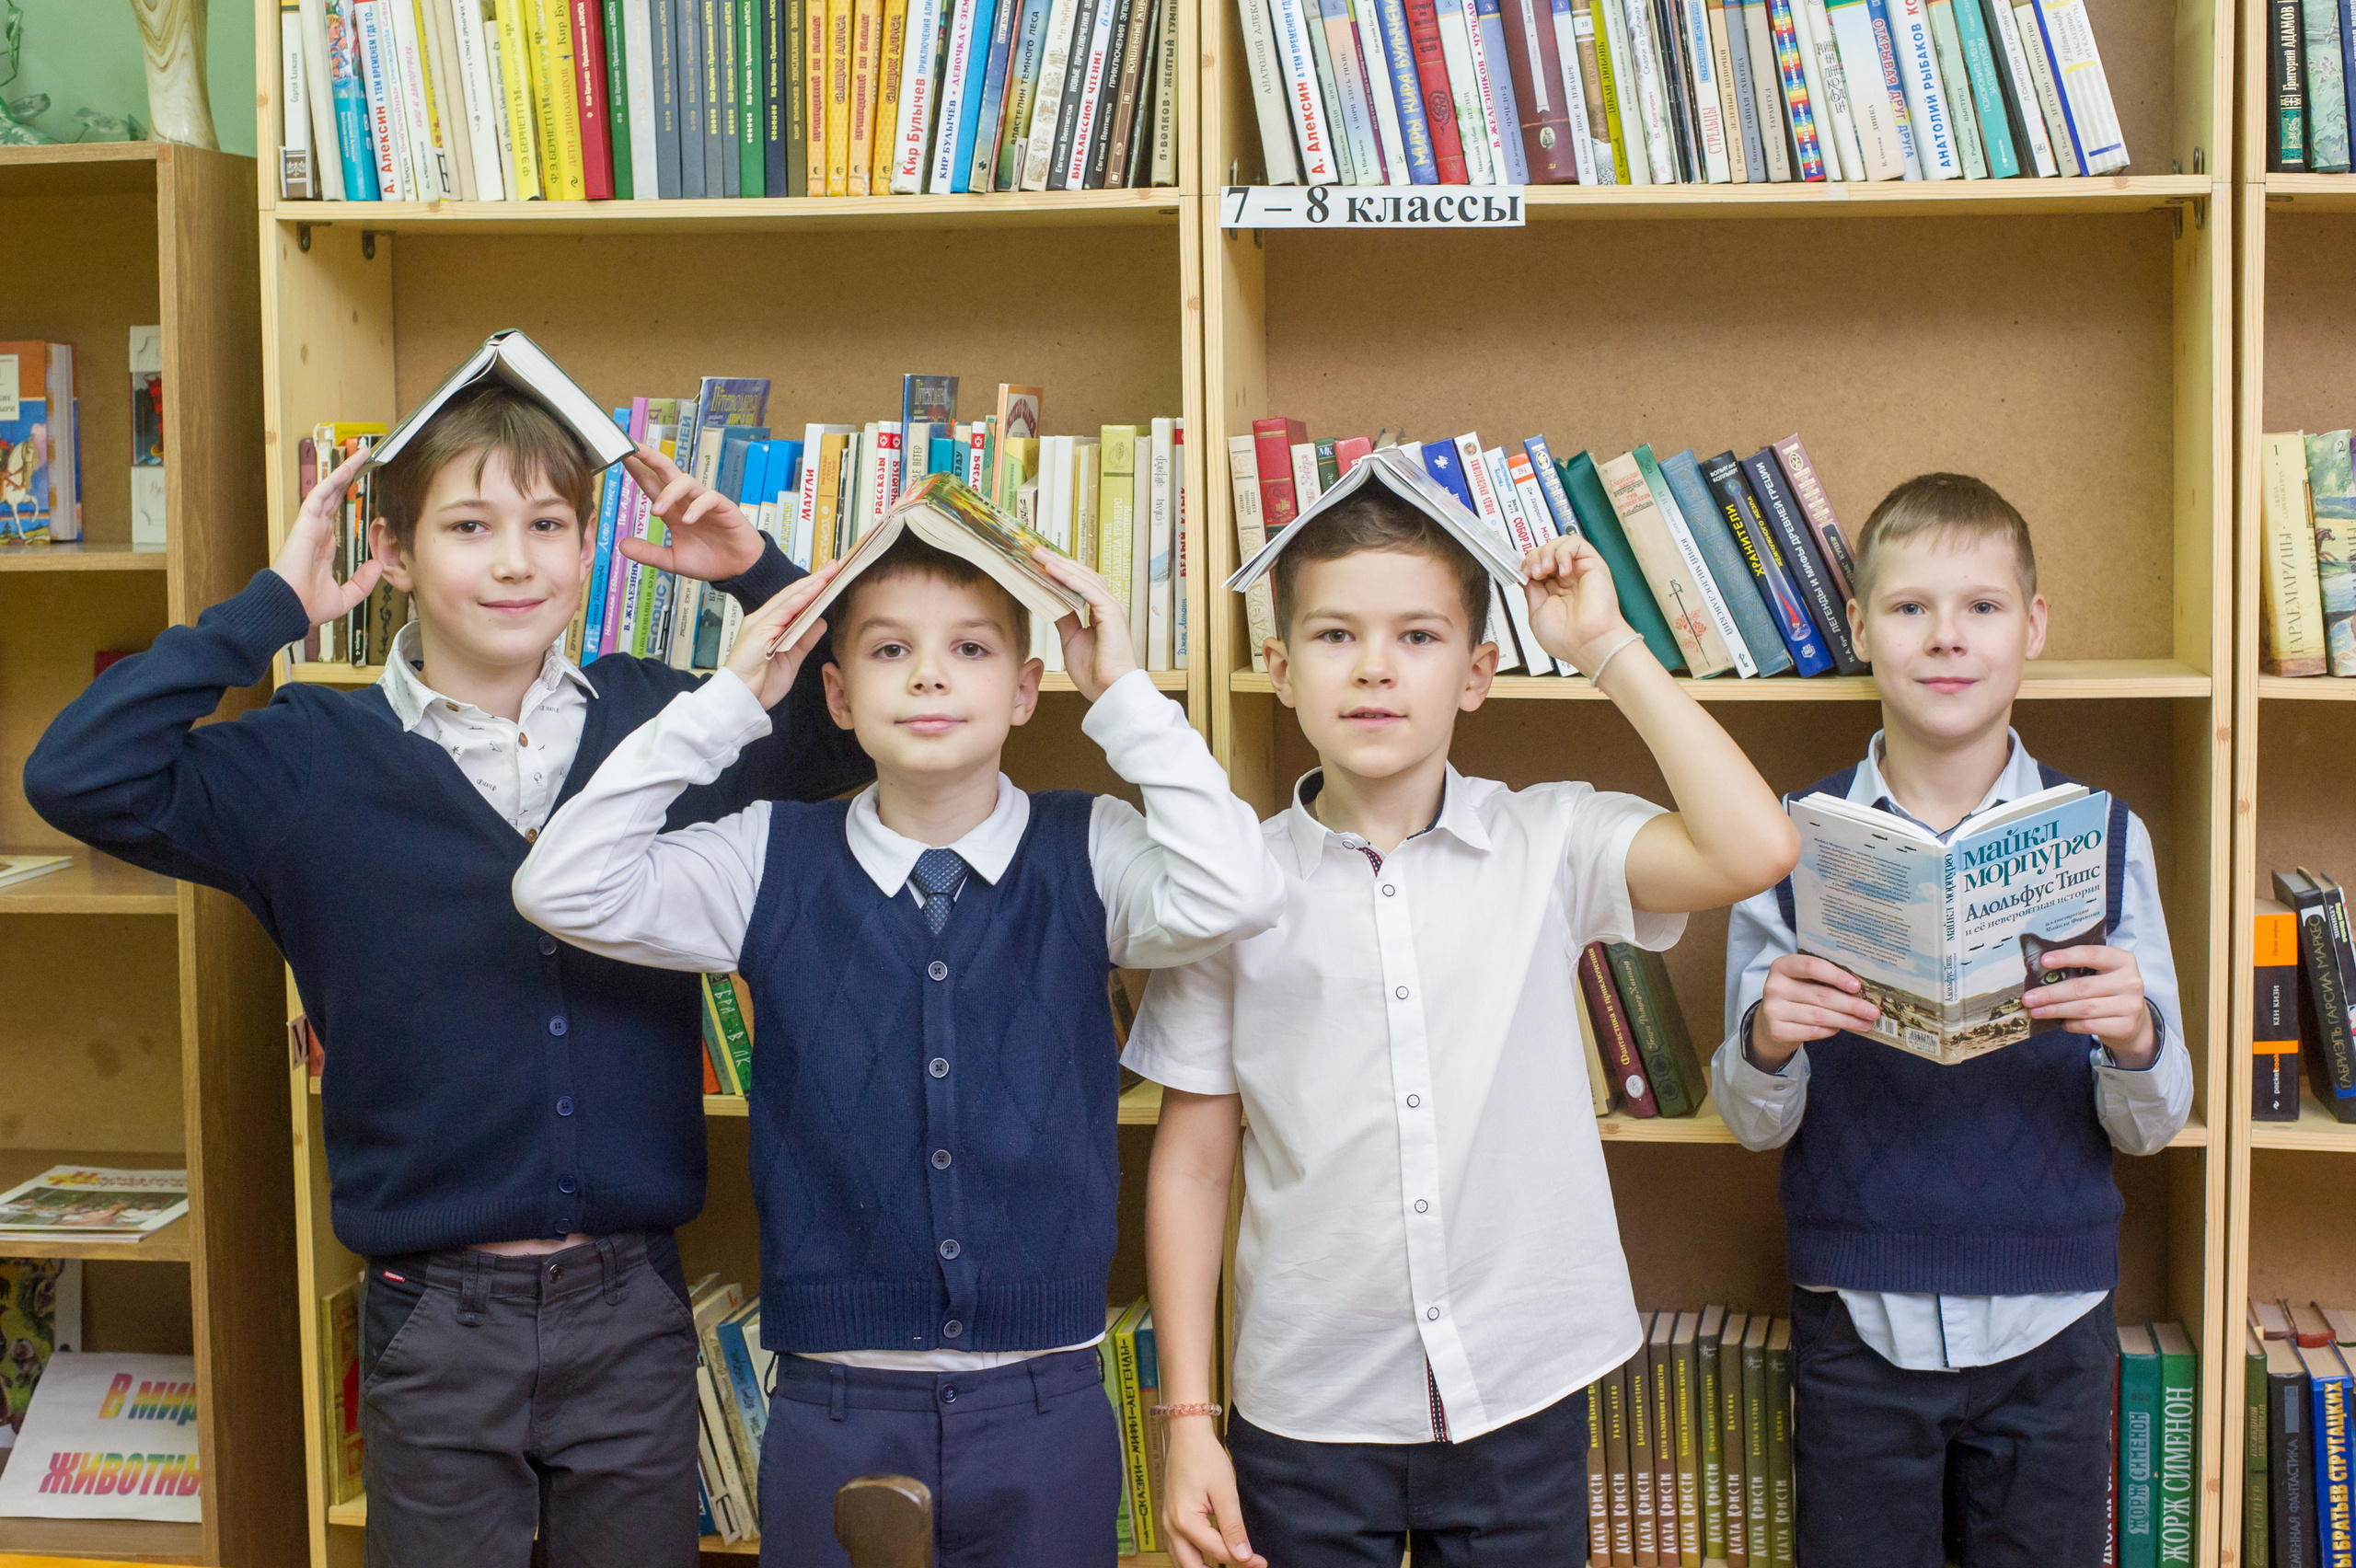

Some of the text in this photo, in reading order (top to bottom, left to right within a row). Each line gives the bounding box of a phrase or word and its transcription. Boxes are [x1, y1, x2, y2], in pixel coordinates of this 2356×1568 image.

[557, 21, 567, 45] Кир
[1128, 22, 1142, 73] ВОЛШЕБНЫЕ
[2065, 11, 2082, 55] НАСЛЕДНИК
[2072, 4, 2087, 46] КАЛЬКУТТЫ
[2281, 6, 2299, 90] Григорий АДАМОВ
[290, 52, 299, 102] Сергей Алексеев
[369, 40, 381, 78] ВРЕМЕНЕМ
[813, 58, 820, 70] НЕ
[834, 15, 846, 104] СЫЩИК АЛИСА
[885, 15, 901, 103] СЫЩИК АЛИСА
[1011, 11, 1040, 144] ВЛАСТЕЛИН ТЕМНОГО ЛЕСА
[1088, 50, 1103, 94] ЧТЕНИЕ
[1255, 40, 1272, 94] АНАТОЛИЙ
[1467, 3, 1497, 135] ЖЕЛЕЗНИКОВ ЧУЧЕЛО
[1598, 41, 1617, 116] ДИКАЯ ЛЮБОВЬ
[1634, 6, 1658, 128] Крапивин Сказки рыбаках
[1690, 3, 1723, 154] СТРЕЛЬЦЫ СТРАНИЦЫ ИСТОРИИ
[1872, 18, 1914, 157] ОТКРЫВАЯ ДРУГ ДРУГА
[1968, 40, 1992, 111] ПОХОРОНИТЕ МЕНЯ
[1978, 37, 1994, 84] ПЛИНТУСОМ
[2027, 21, 2059, 118] ДЕТСТВО ОТРОЧЕСТВО
[561, 68, 577, 167] ДЕТИ ДИНОЗАВРОВ
[811, 76, 822, 142] ПРИВИДЕНИЙ
[903, 18, 931, 175] Кир Булычев ПРИКЛЮЧЕНИЯ
[940, 34, 965, 179] КИР БУЛЫЧЁВ ДЕВОЧКА
[1055, 12, 1091, 173] Евгений Велтистов НОВЫЕ ПРИКЛЮЧЕНИЯ
[1096, 24, 1126, 171] Евгений Велтистов ПРИКЛЮЧЕНИЯ
[1285, 12, 1325, 174] А. Алексин ТЕМ ВРЕМЕНЕМ
[1464, 92, 1473, 120] БЕГЛЕЦ
[1567, 64, 1584, 133] ДВОЕ ДЕКАБРЕ
[1720, 49, 1737, 131] ЗЕЛЕНЫЕ ЦЕПОЧКИ
[1738, 57, 1753, 130] ТАЙНАЯ СХВАТКА
[1765, 87, 1776, 129] ТАРАНТУЛ
[1782, 32, 1818, 174] Андрей Некрасов Приключения
[1868, 104, 1879, 132] ДИНКА
[1911, 23, 1951, 167] АНАТОЛИЙ РЫБАКОВ
[1958, 87, 1969, 121] ВЫСТРЕЛ
[376, 106, 392, 172] Алексин
[517, 109, 529, 153] БЕРНЕТТ
[544, 115, 557, 159] БЕРНЕТТ
[1399, 74, 1430, 166] МИРЫ КИРА
[384, 179, 395, 194] А.
[1227, 186, 1520, 224] 7 8 классы
[913, 445, 922, 467] ВЕТЕР
[1755, 462, 1778, 500] ГРЕЦИИ
[636, 492, 647, 535] ЧУЧЕЛО
[1470, 459, 1496, 514] ВОЖДЬ КРАСНОКОЖИХ
[1114, 498, 1123, 536] ТРЭВЕРС
[1123, 505, 1132, 580] СЕНТ-ЭКЗЮПЕРИ
[1513, 517, 1529, 540] СОБОР
[1725, 504, 1764, 576] ХРАНИТЕЛИ
[1748, 496, 1784, 567] ЖЕМЧУЖНОГО ЖЕЗЛА
[1771, 501, 1800, 545] ДРЕВНЕЙ
[1103, 524, 1112, 569] ЛИНДГРЕН
[1794, 546, 1814, 577] МИФЫ
[1680, 538, 1734, 635] ЮРИЙ МИЛОСЛАВСКИЙ
[1812, 587, 1841, 633] ЛЕГЕНДЫ
[2279, 533, 2304, 654] ГАРДЕМАРИНЫ
[605, 596, 615, 636] Наталья
[680, 607, 689, 637] ЛЮДВИК
[1177, 598, 1187, 656] Джек Лондон
[1963, 820, 2060, 870] майкл
[1964, 830, 2102, 893] морпурго
[1945, 853, 1957, 905] морпурго
[1966, 865, 2100, 923] Адольфус Типс
[1988, 900, 2055, 928] невероятная
[2057, 884, 2101, 905] история
[1944, 907, 1956, 941] майкл
[1588, 948, 1612, 1004] приключения
[1623, 961, 1658, 1048] Генри Райдер Хаггард
[1945, 970, 1954, 1002] Адольфус
[2305, 916, 2351, 1088] ГАБРИЭЛЬ ГАРСИА МАРКЕС
[1611, 1013, 1630, 1065] Фантастика
[98, 1373, 198, 1425] В мир
[1121, 1345, 1135, 1406] ЛЕГЕНДЫ
[1134, 1465, 1148, 1516] СКАЗКИ
[2128, 1412, 2148, 1531] ЖОРЖ СИМЕНОН
[2163, 1387, 2193, 1563] ЖОРЖ СИМЕНОН
[2287, 1438, 2300, 1512] ФАНТАСТИКА
[2325, 1380, 2350, 1551] БРАТЬЕВ СТРУГАЦКИХ
